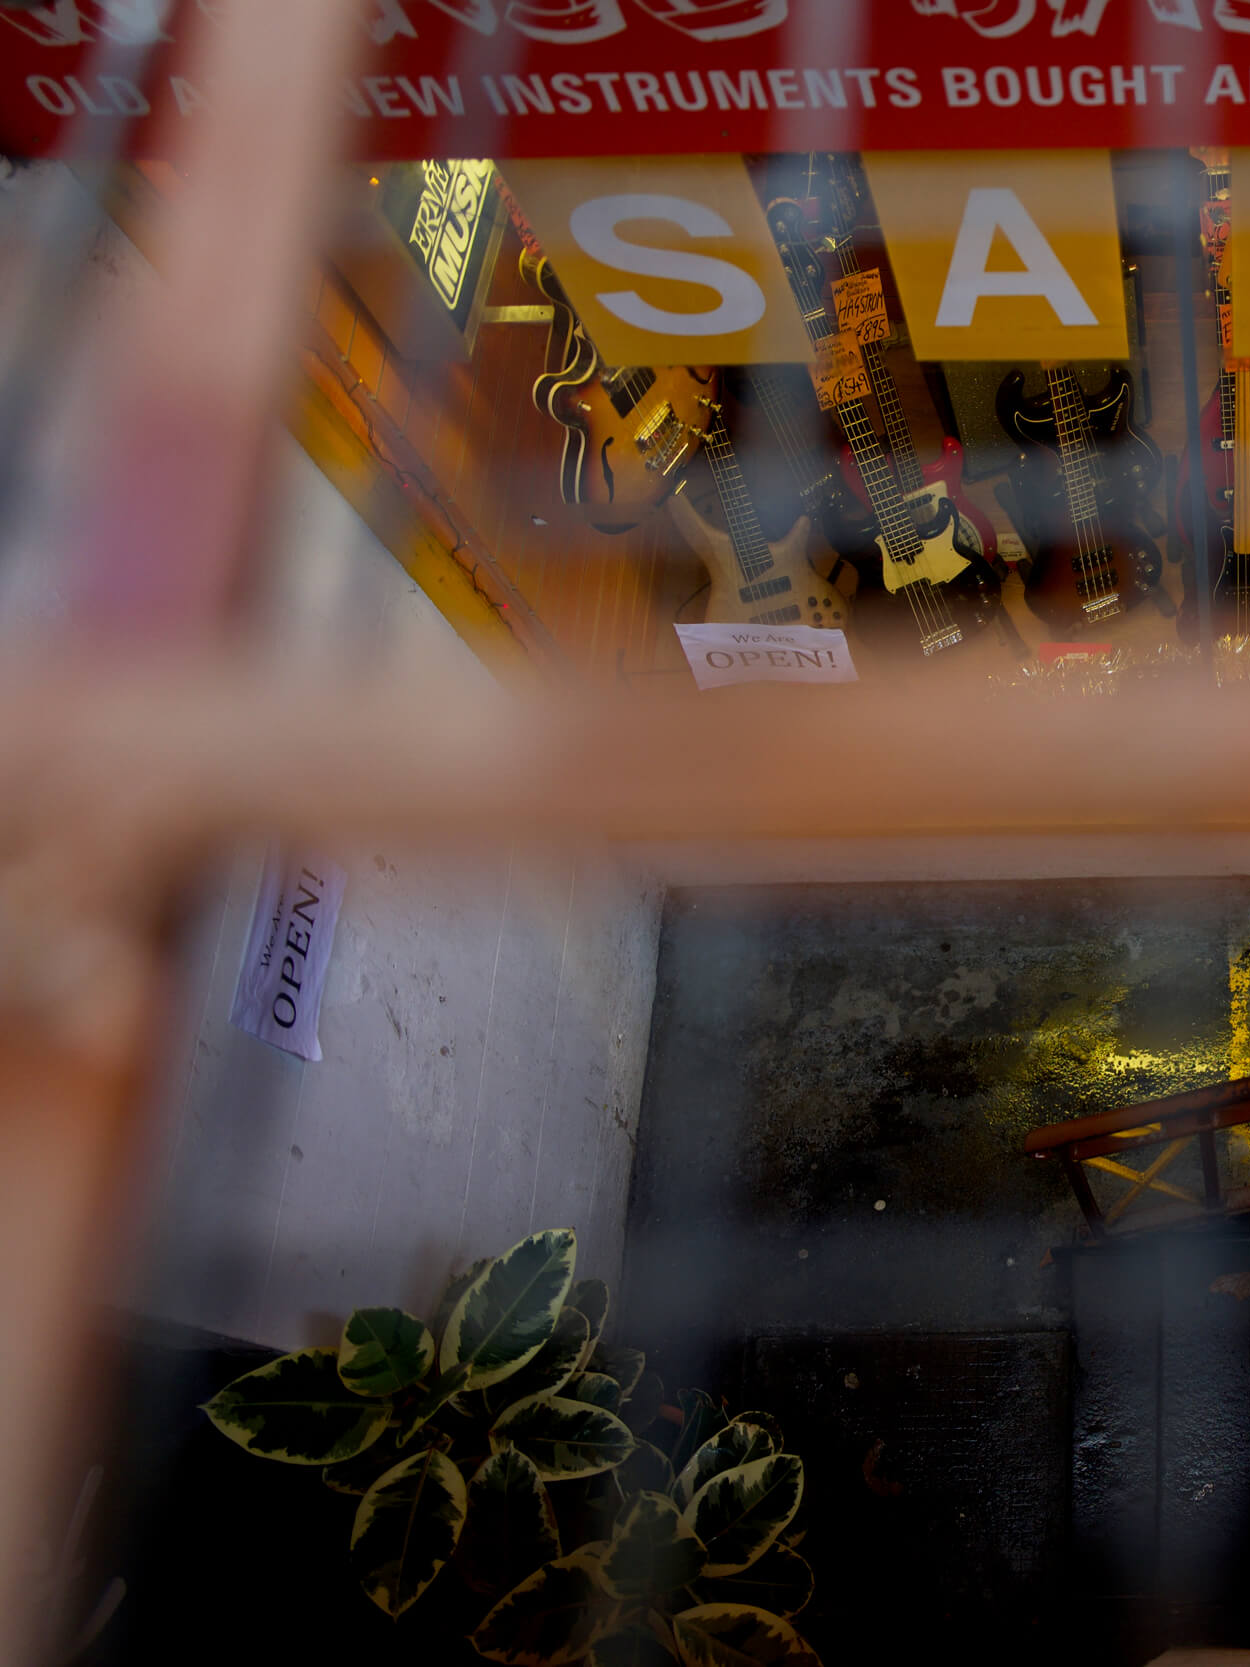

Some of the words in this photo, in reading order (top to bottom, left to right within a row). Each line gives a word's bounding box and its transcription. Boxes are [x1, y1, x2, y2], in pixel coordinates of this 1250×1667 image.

[24, 73, 151, 117] OLD
[480, 66, 924, 117] INSTRUMENTS
[941, 64, 1186, 108] BOUGHT
[408, 158, 450, 265] ERNIE
[705, 650, 838, 669] OPEN!
[273, 868, 325, 1029] OPEN!
